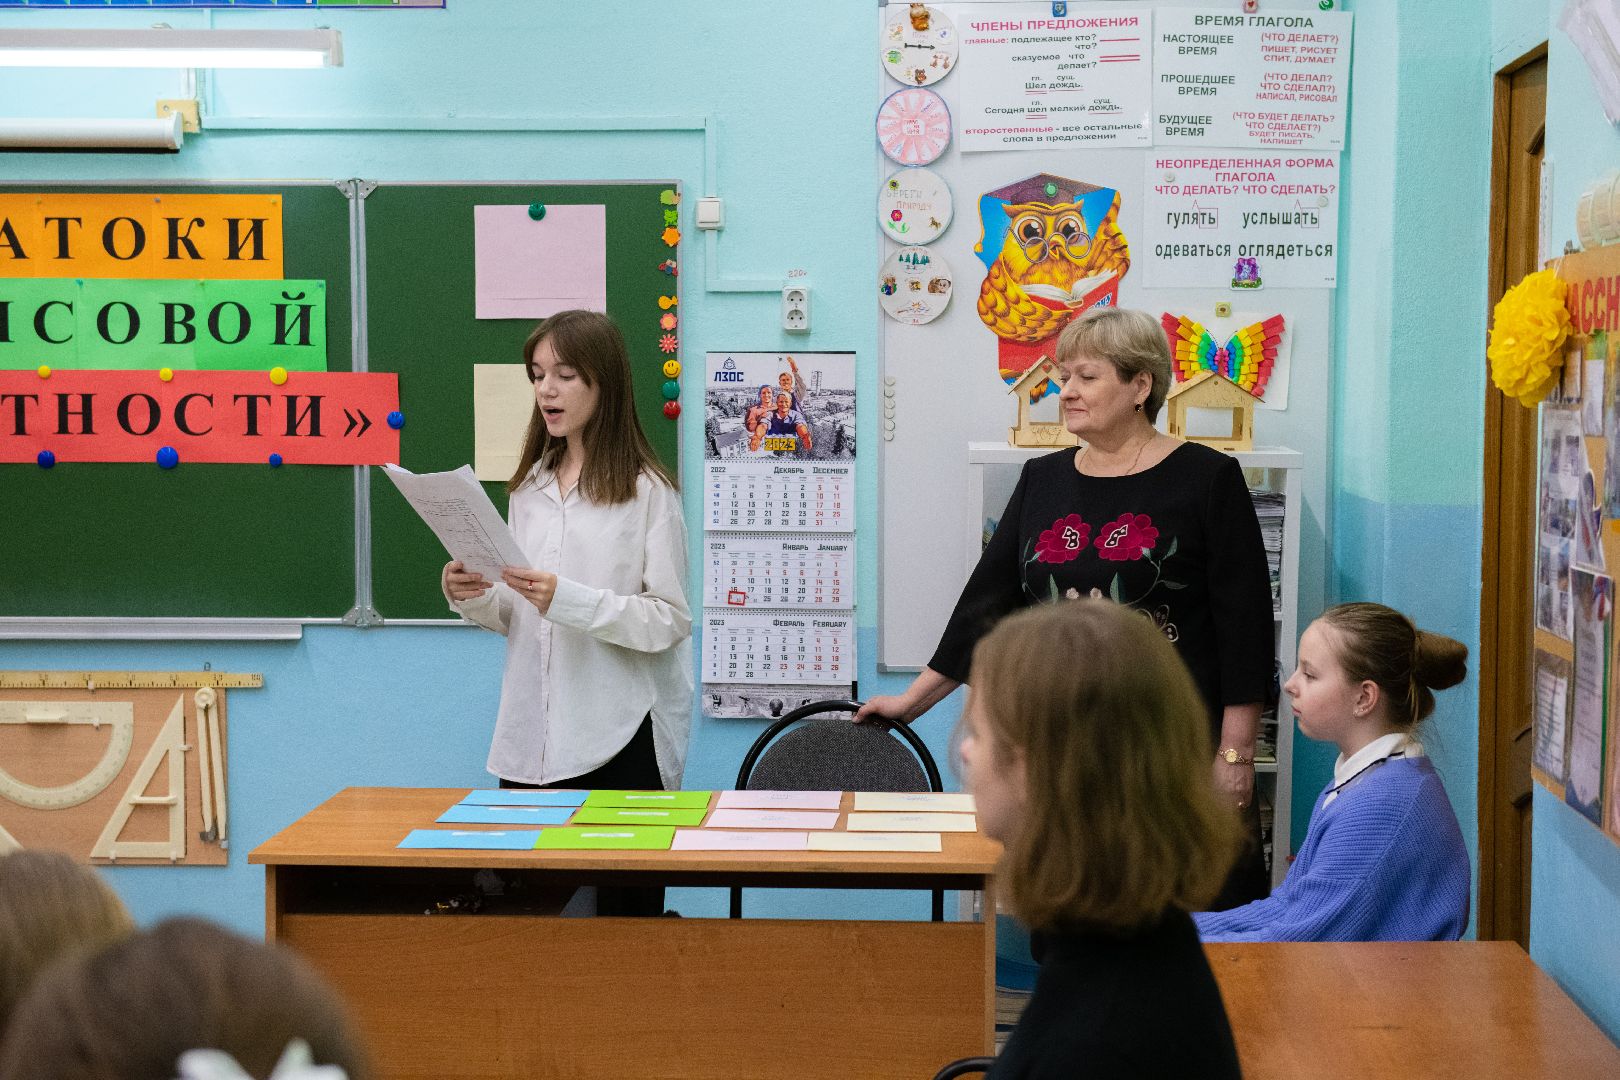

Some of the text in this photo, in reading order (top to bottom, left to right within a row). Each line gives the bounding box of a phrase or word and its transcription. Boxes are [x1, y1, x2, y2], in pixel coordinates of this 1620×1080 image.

[971, 17, 1138, 31] ЧЛЕНЫ ПРЕДЛОЖЕНИЯ
[1195, 15, 1313, 28] ВРЕМЯ ГЛАГОЛА
[1011, 35, 1072, 43] подлежащее
[1076, 33, 1096, 41] кто?
[1163, 34, 1234, 44] НАСТОЯЩЕЕ
[1261, 33, 1339, 43] (ЧТО ДЕЛАЕТ?)
[1179, 46, 1217, 55] ВРЕМЯ
[1301, 46, 1338, 54] РИСУЕТ
[1012, 54, 1060, 62] сказуемое
[1264, 55, 1336, 64] СПИТ, ДУМАЕТ
[1058, 62, 1096, 70] делает?
[1161, 74, 1235, 85] ПРОШЕДШЕЕ
[1264, 73, 1332, 82] (ЧТО ДЕЛАЛ?
[1049, 82, 1083, 90] дождь.
[1284, 83, 1335, 93] СДЕЛАЛ?)
[1178, 87, 1216, 96] ВРЕМЯ
[1256, 92, 1337, 102] НАПИСАЛ, РИСОВАЛ
[1159, 115, 1212, 125] БУДУЩЕЕ
[1232, 112, 1334, 123] (ЧТО БУДЕТ ДЕЛАТЬ?
[966, 126, 1053, 135] второстепенные
[1084, 123, 1142, 131] остальные
[1166, 128, 1204, 136] ВРЕМЯ
[1268, 123, 1320, 132] СДЕЛАЕТ?)
[1046, 134, 1116, 142] предложении
[1156, 159, 1334, 170] НЕОПРЕДЕЛЕННАЯ ФОРМА
[1216, 172, 1275, 182] ГЛАГОЛА
[1155, 185, 1335, 196] ЧТО ДЕЛАТЬ? ЧТО СДЕЛАТЬ?
[1168, 212, 1318, 229] гулять услышать
[0, 216, 269, 261] АТОКИ
[1156, 244, 1332, 259] одеваться оглядеться
[714, 372, 744, 382] ЛЗОС
